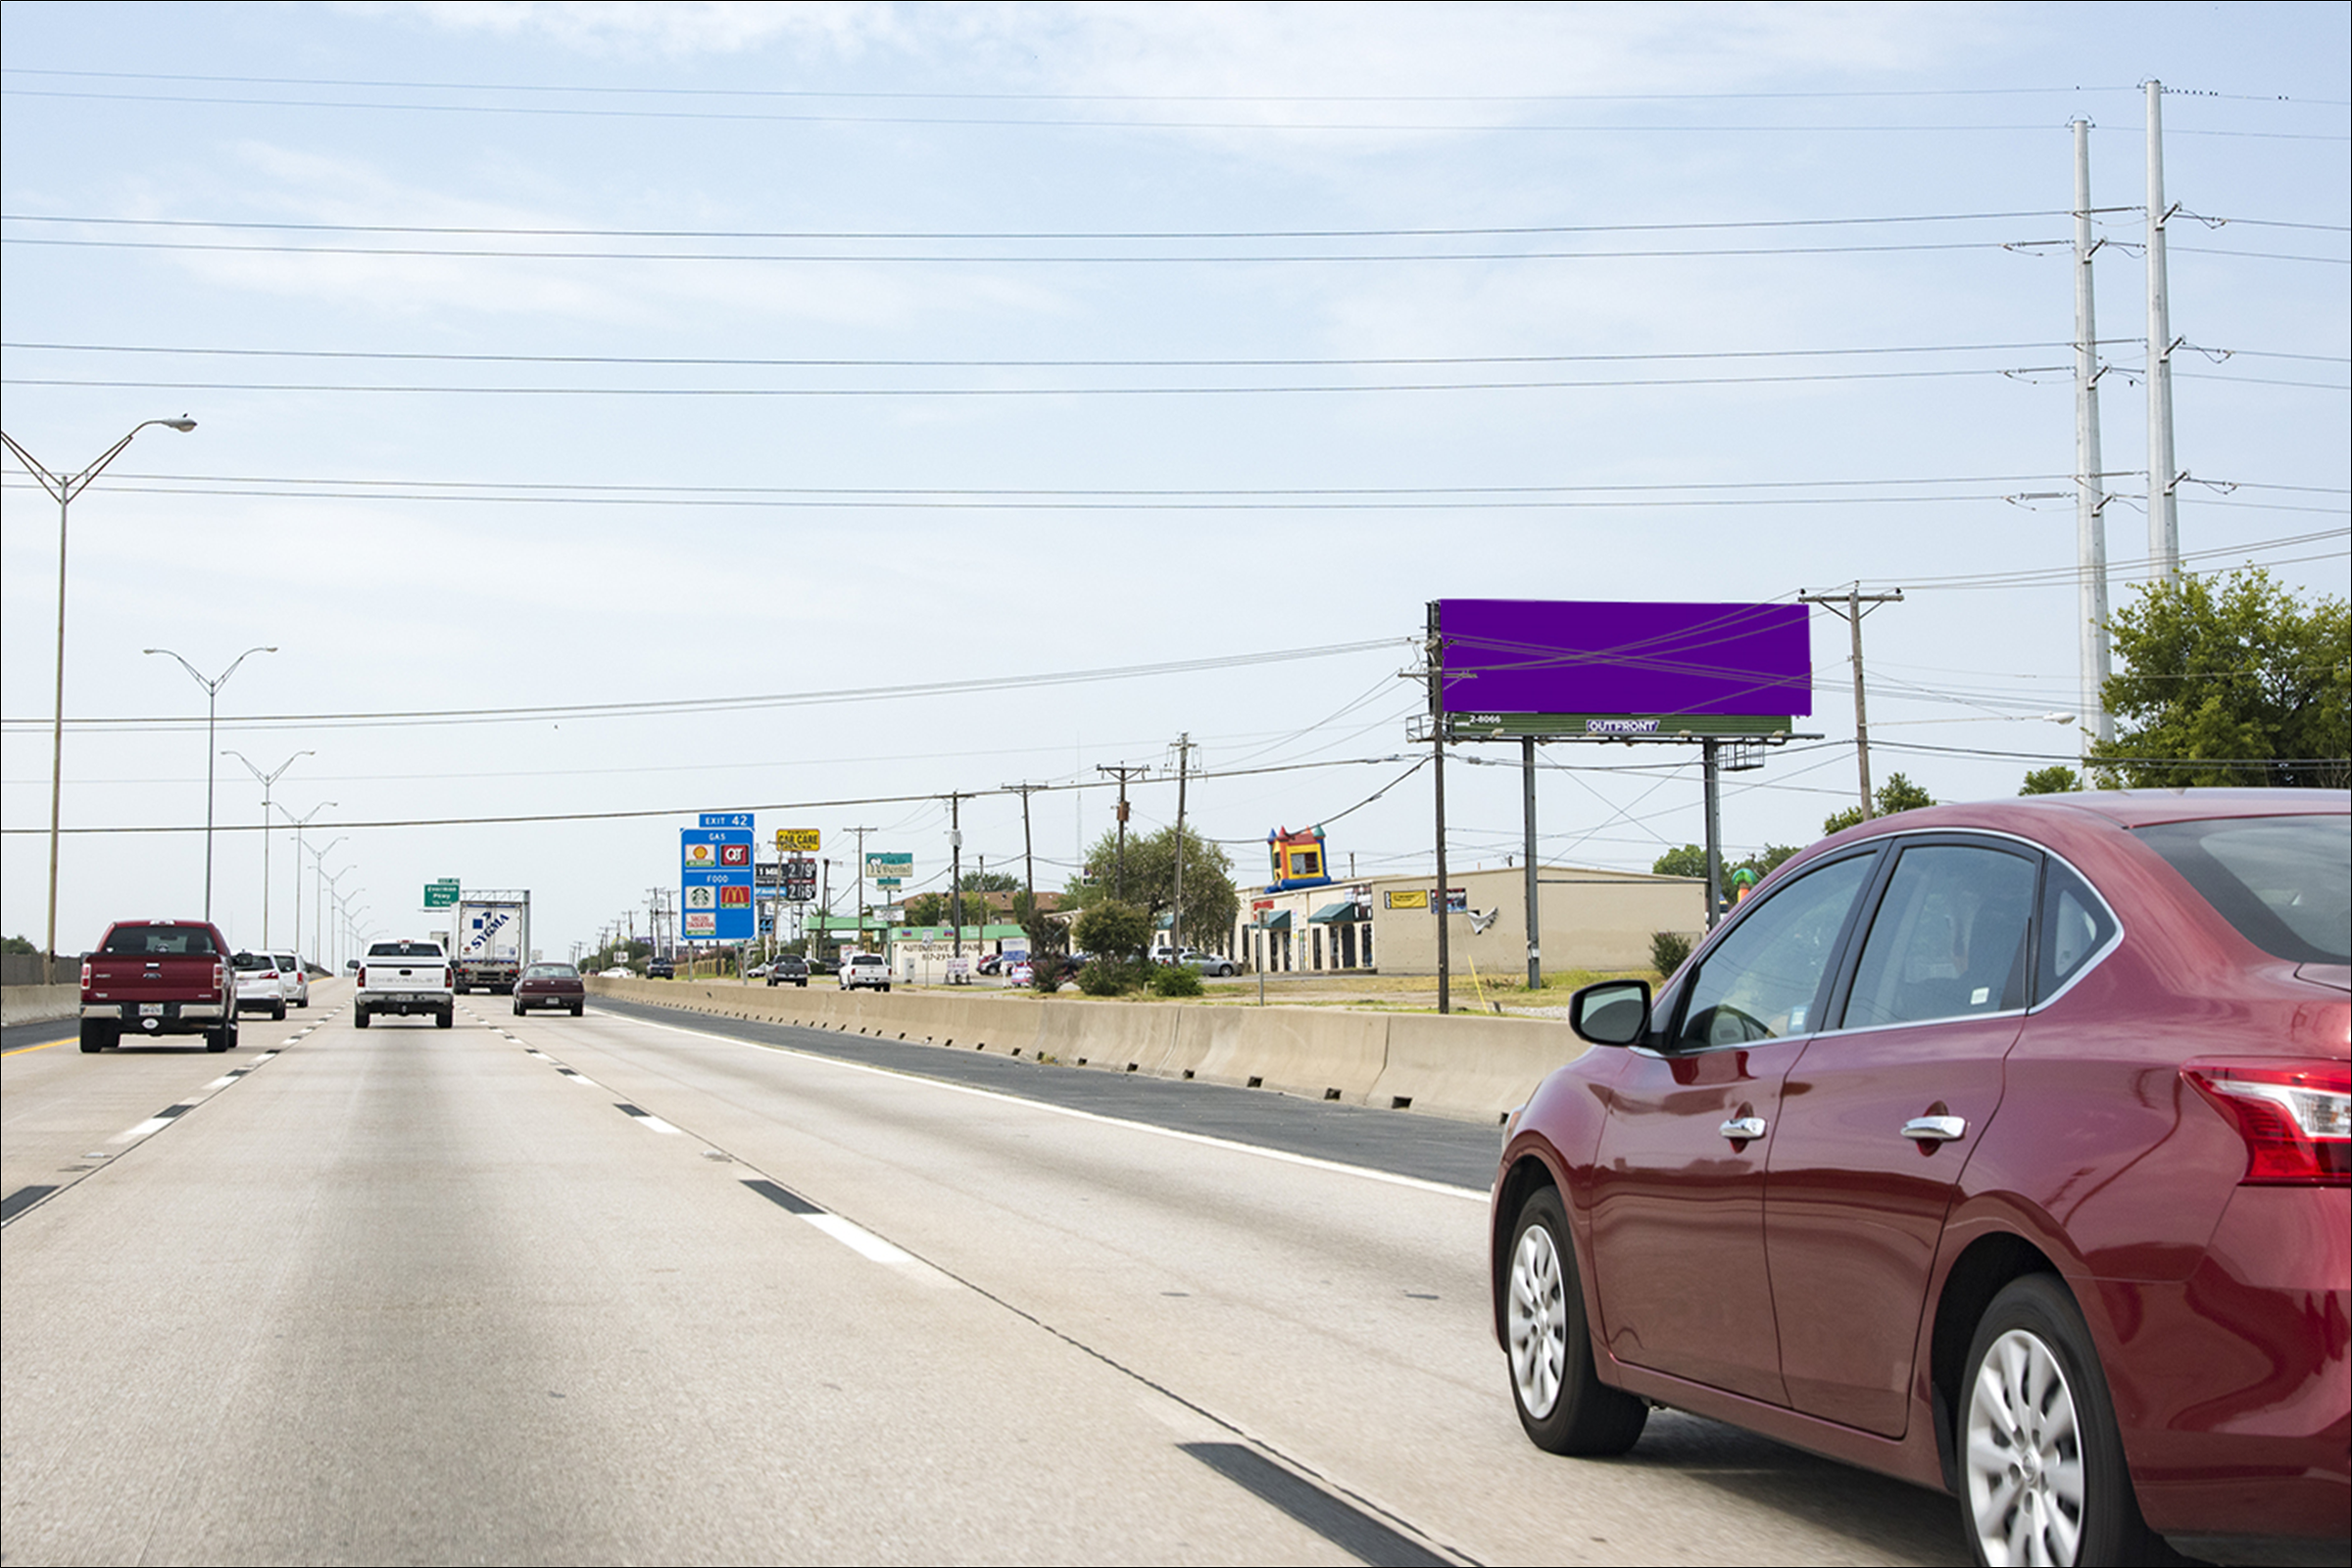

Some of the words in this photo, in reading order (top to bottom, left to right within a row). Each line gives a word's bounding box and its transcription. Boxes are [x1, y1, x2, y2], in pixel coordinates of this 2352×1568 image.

[1589, 719, 1656, 732] OUTFRONT
[705, 816, 725, 825] EXIT
[731, 815, 748, 826] 42
[708, 832, 726, 841] GAS
[797, 834, 818, 845] CARE
[725, 847, 745, 862] QT
[707, 874, 729, 883] FOOD
[471, 913, 510, 950] SYGMA
